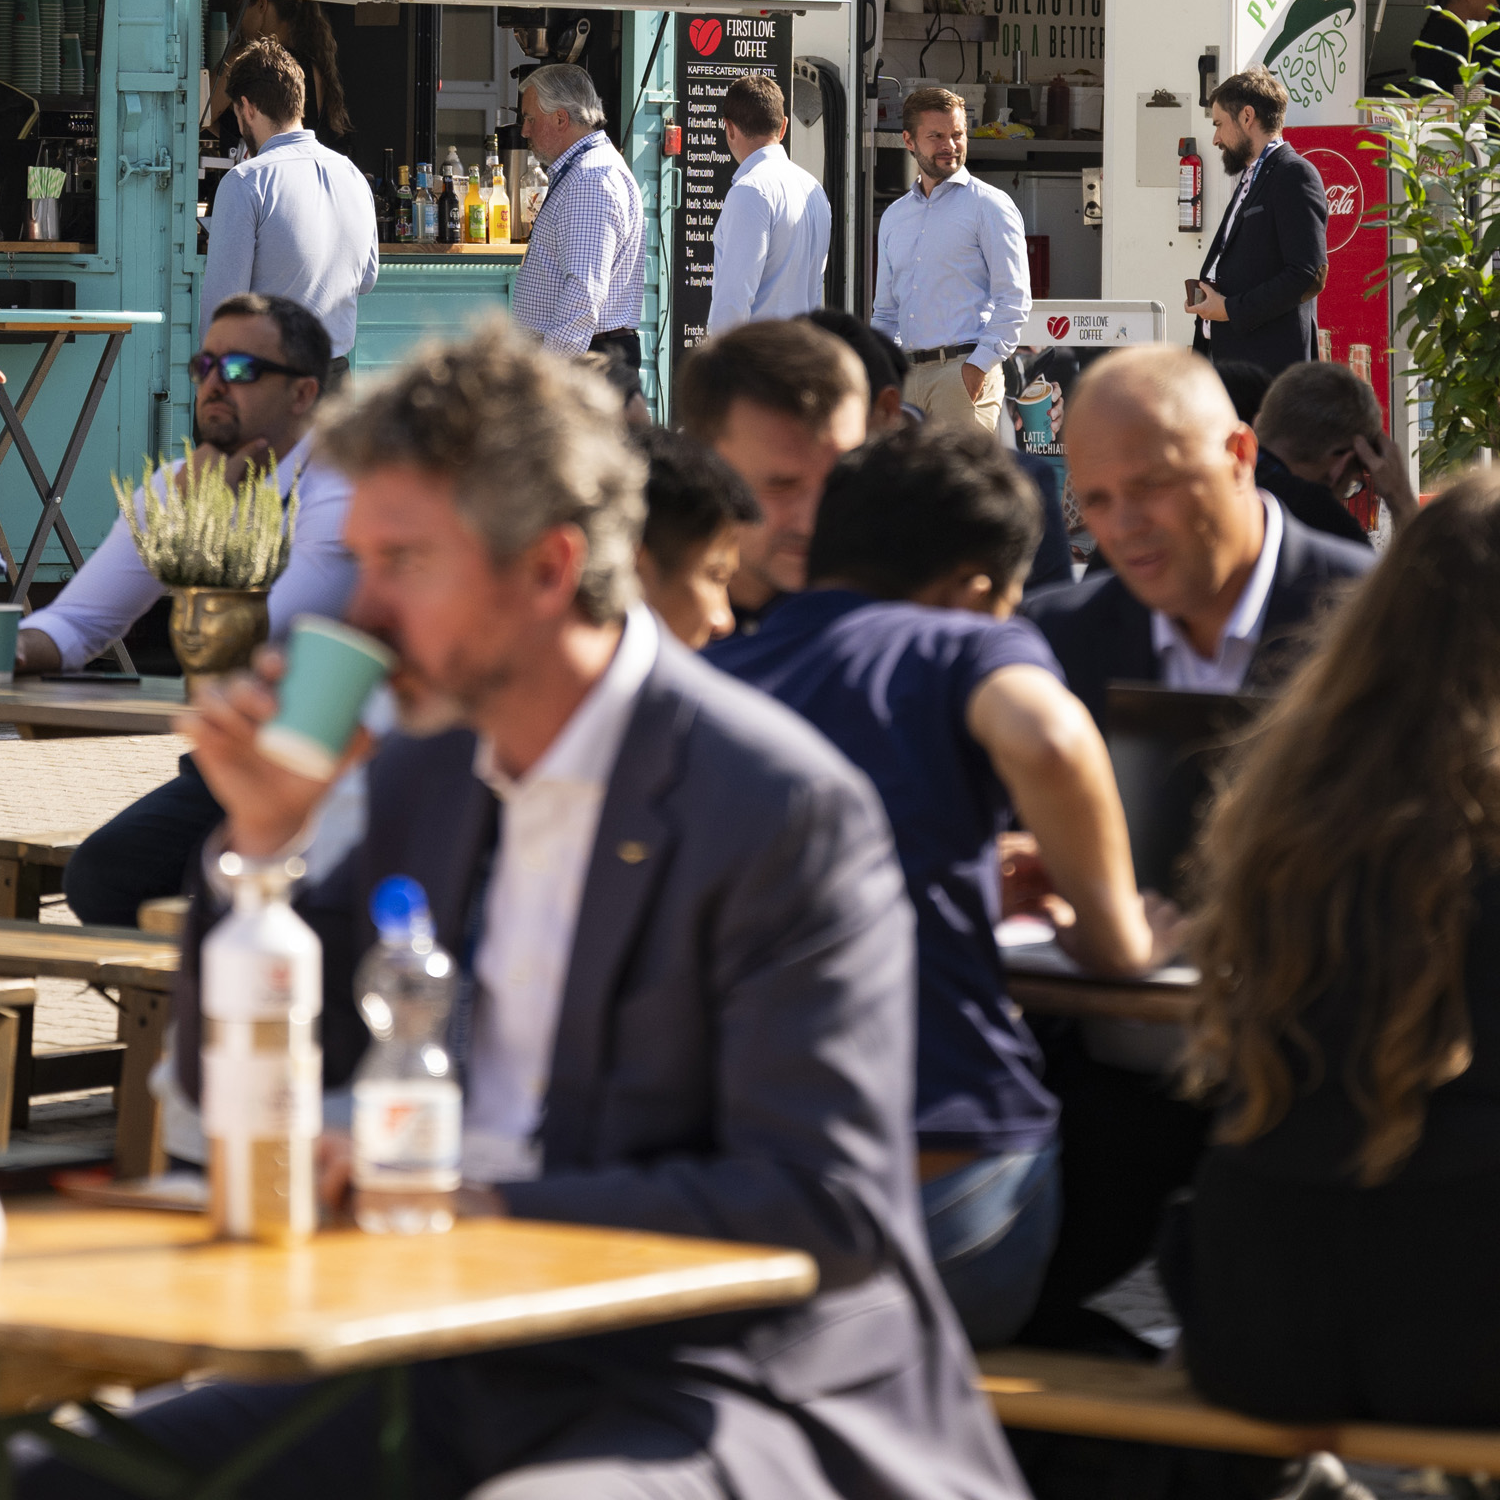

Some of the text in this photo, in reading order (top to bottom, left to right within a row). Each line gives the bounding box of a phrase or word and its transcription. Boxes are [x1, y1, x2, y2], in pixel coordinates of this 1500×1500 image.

[726, 19, 776, 38] FIRST LOVE
[1032, 24, 1039, 57] A
[1049, 25, 1105, 59] BETTER
[734, 40, 768, 58] COFFEE
[687, 65, 777, 78] KAFFEE-CATERING MIT STIL
[688, 84, 704, 96] Latte
[687, 100, 717, 114] Cappuccino
[687, 117, 717, 129] Filterkaffee
[687, 133, 717, 145] Flat White
[687, 150, 731, 164] Espresso/Doppio
[687, 166, 714, 177] Americano
[686, 214, 714, 225] Chai Latte
[686, 230, 705, 241] Matcha
[1073, 315, 1109, 327] FIRST LOVE
[684, 323, 704, 336] Frische
[1079, 329, 1103, 340] COFFEE
[1023, 431, 1046, 444] LATTE
